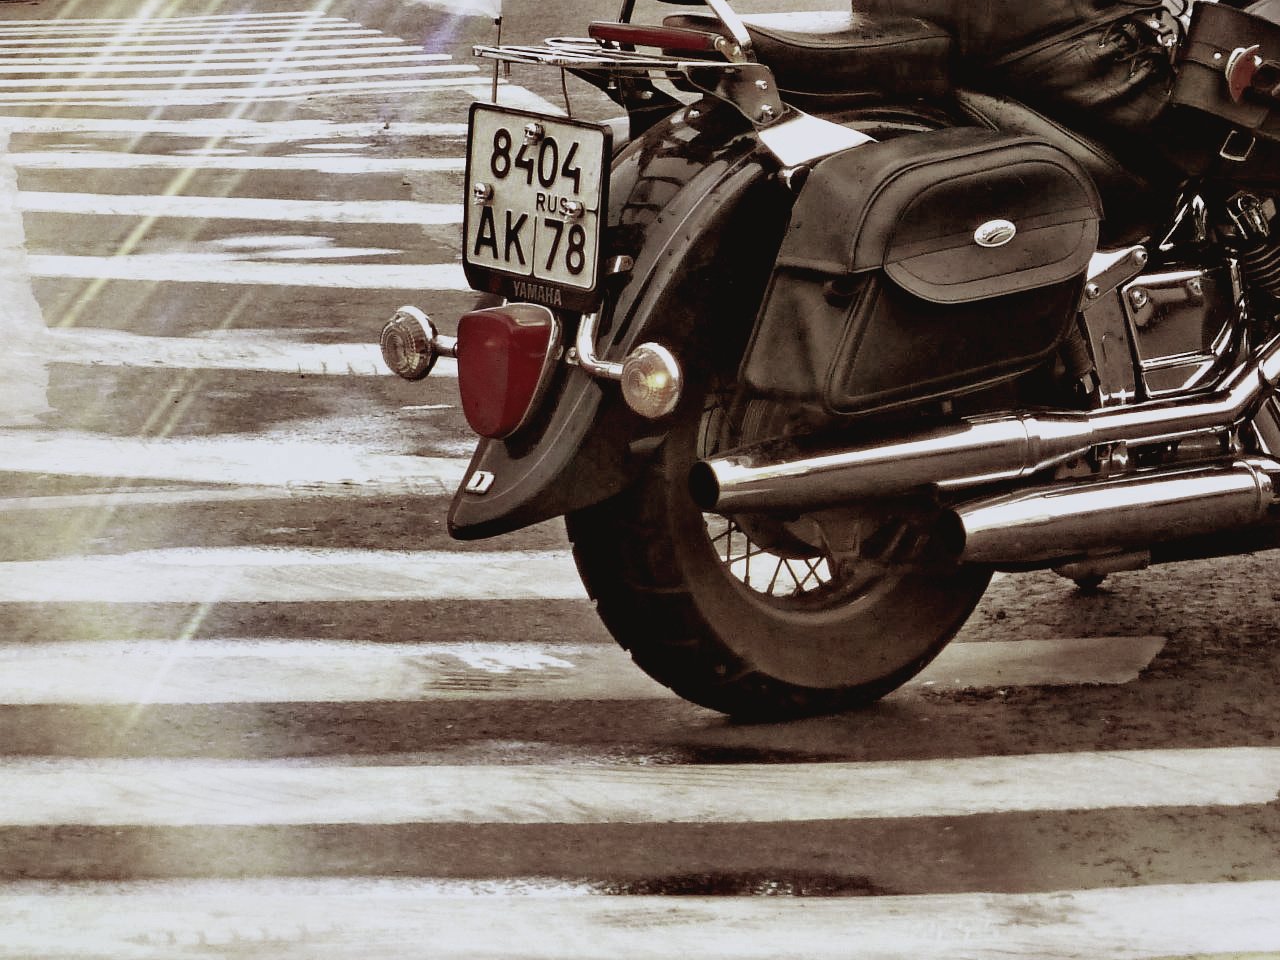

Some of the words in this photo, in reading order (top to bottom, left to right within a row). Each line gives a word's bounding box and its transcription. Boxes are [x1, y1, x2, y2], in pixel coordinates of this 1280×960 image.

[490, 127, 582, 195] 8404
[535, 192, 568, 216] RUS
[544, 218, 586, 275] 78
[513, 280, 563, 306] YAMAHA
